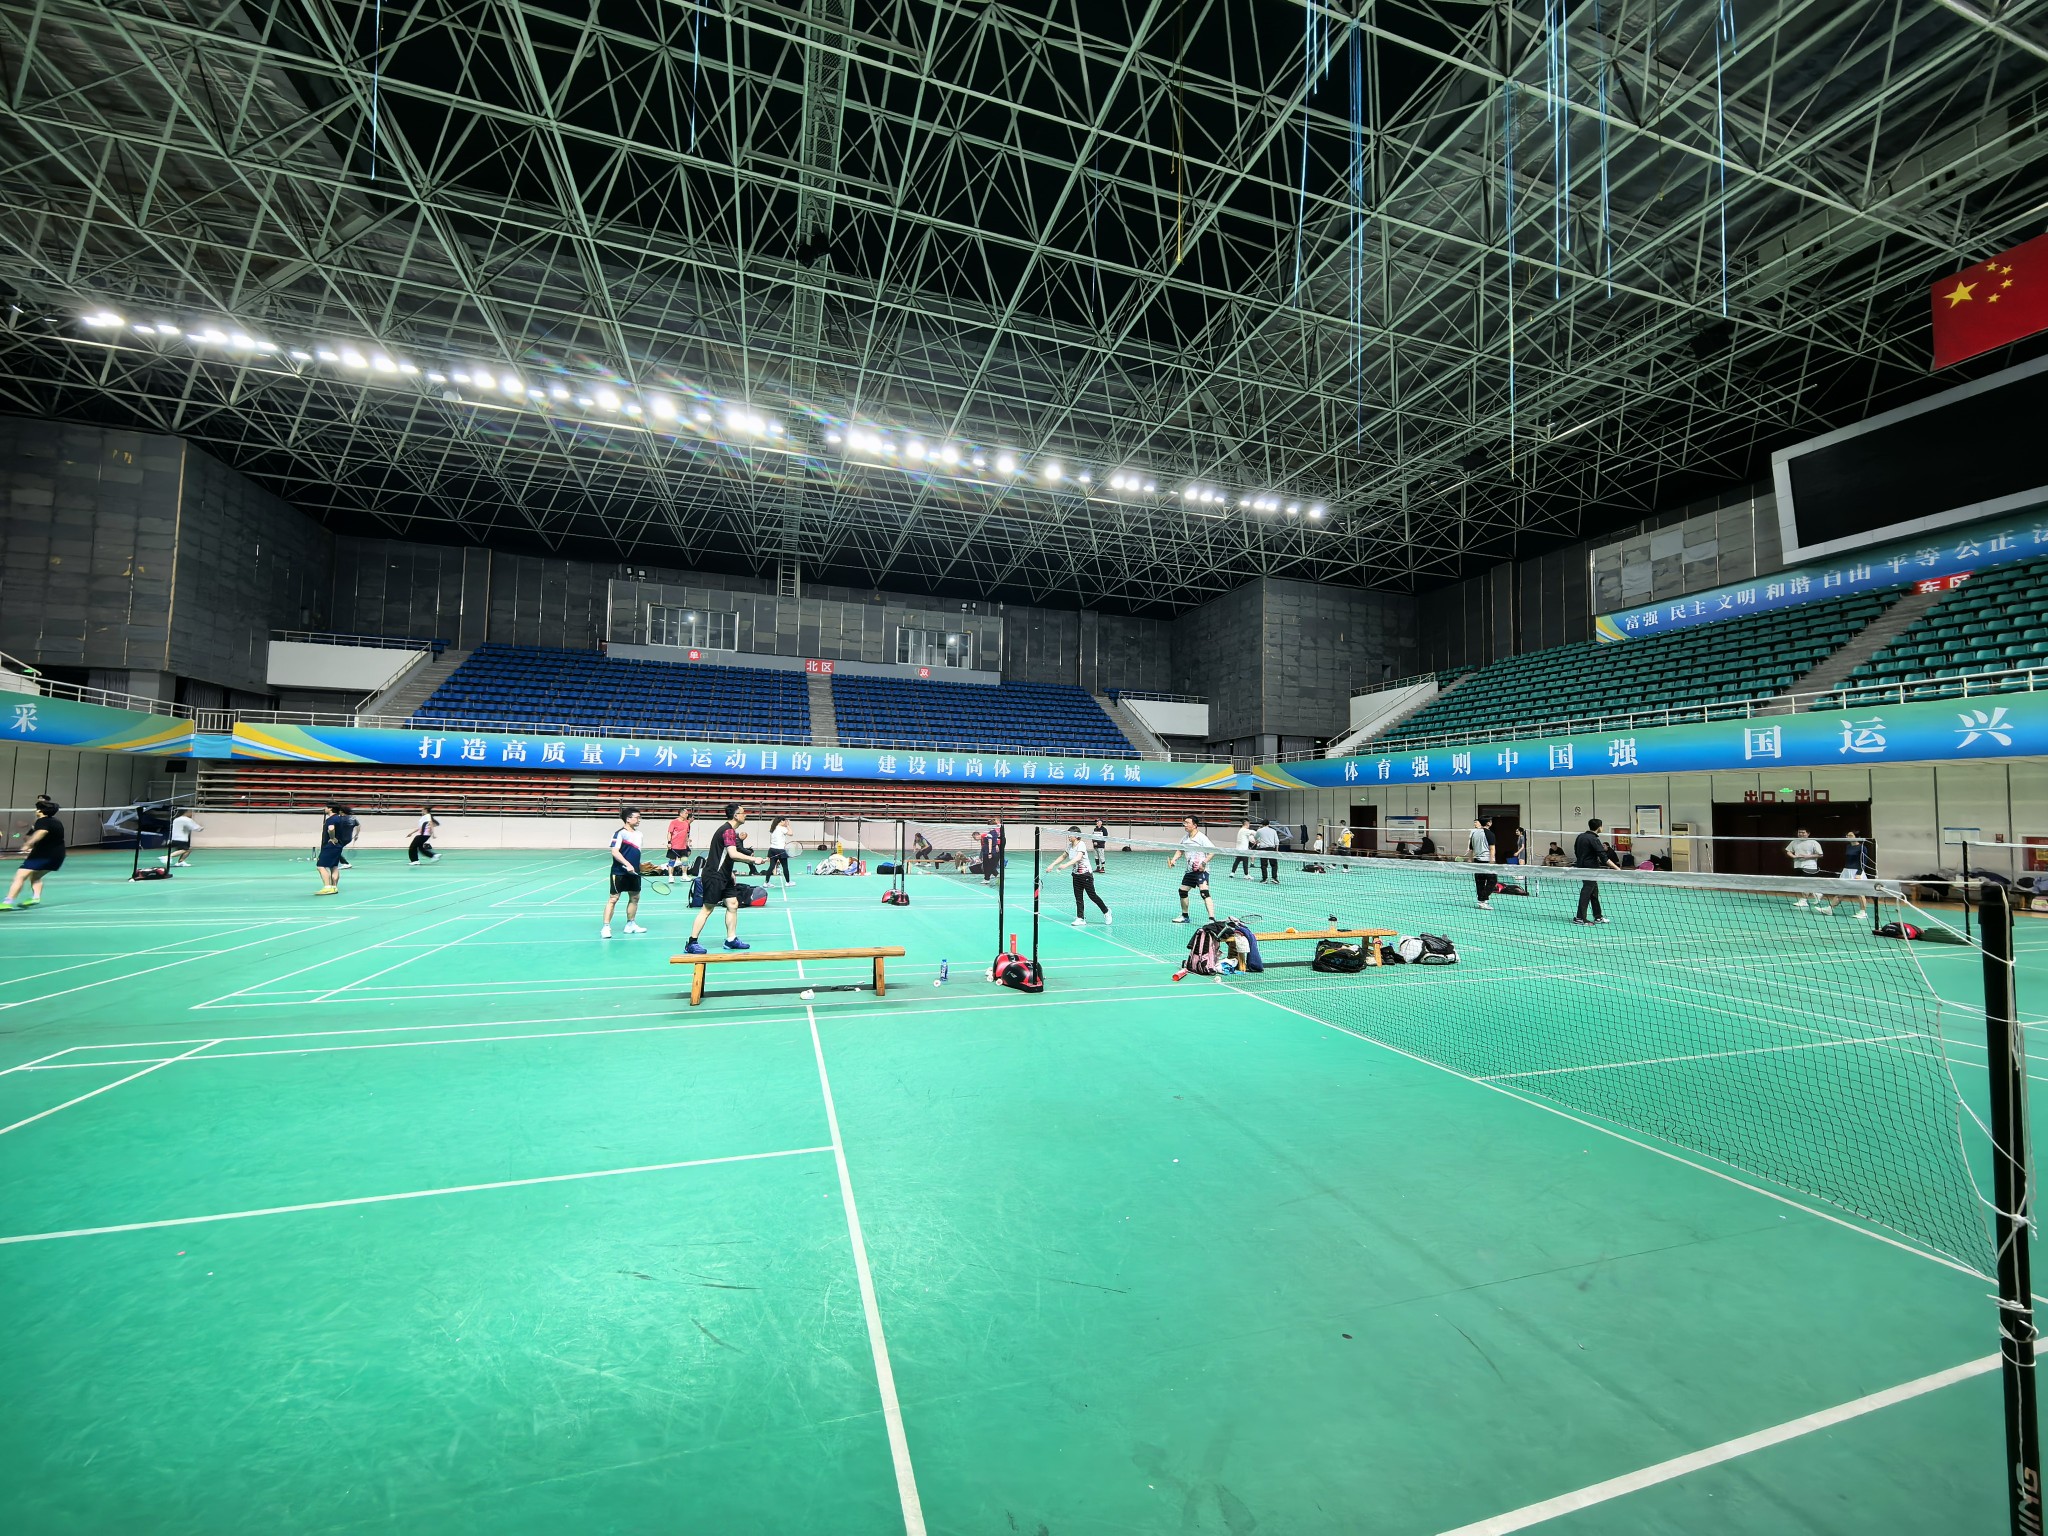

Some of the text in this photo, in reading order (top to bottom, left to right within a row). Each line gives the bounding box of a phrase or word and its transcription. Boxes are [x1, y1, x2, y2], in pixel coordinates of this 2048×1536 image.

[1625, 610, 1659, 631] 富强
[1670, 600, 1706, 621] 民主
[1716, 588, 1756, 611] 文明
[1765, 575, 1812, 600] 和谐
[1823, 563, 1871, 588] 自由
[1883, 546, 1942, 574] 平等
[1953, 530, 2018, 560] 公正
[806, 660, 833, 673] 北区
[10, 702, 38, 733] 采
[418, 735, 1141, 783] 打造高质量户外运动目的地 建设时尚体育运动名城
[1344, 707, 2014, 782] 体育强则中国强 国运兴
[1744, 789, 1830, 803] 出口 出口
